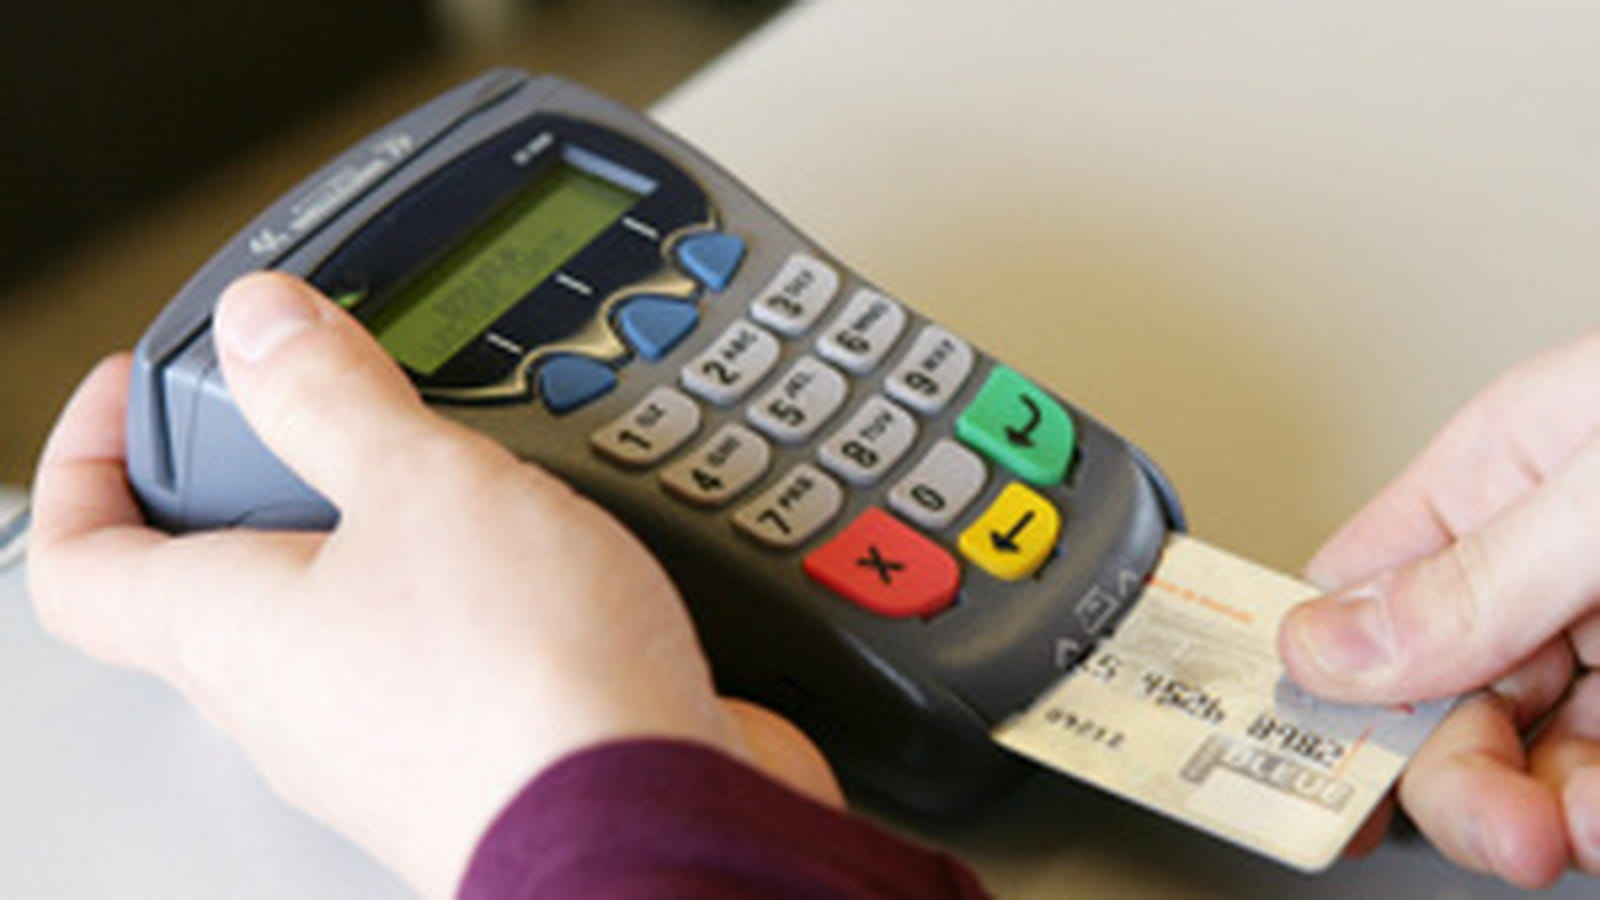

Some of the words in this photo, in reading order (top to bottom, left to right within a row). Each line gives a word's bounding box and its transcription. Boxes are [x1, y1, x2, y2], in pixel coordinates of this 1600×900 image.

[766, 294, 805, 319] 3
[834, 330, 872, 355] 6
[703, 359, 742, 386] 2
[904, 370, 940, 396] 9
[769, 401, 806, 428] 5
[618, 428, 652, 454] 1
[841, 442, 879, 469] 8
[690, 468, 723, 494] 4
[910, 483, 946, 512] 0
[757, 508, 793, 536] 7
